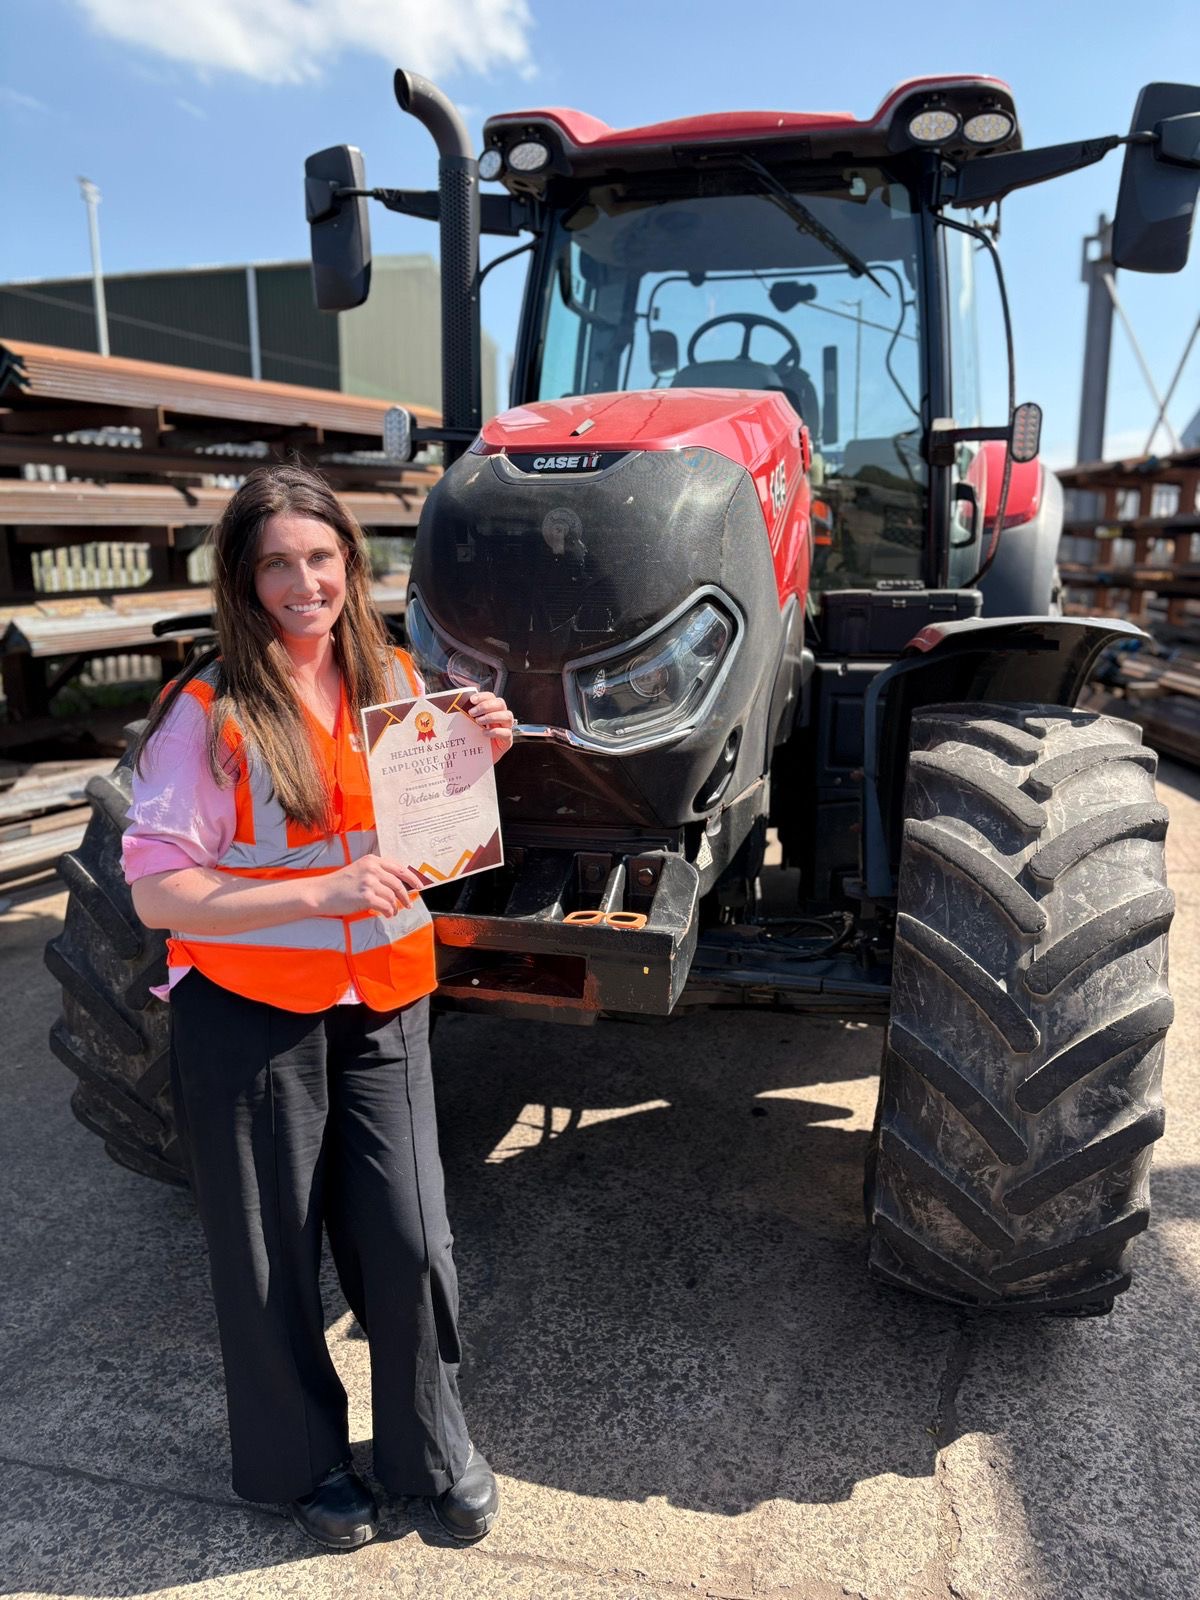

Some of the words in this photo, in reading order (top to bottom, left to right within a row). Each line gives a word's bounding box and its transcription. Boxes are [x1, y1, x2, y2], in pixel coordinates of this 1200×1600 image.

[533, 456, 581, 470] CASE
[390, 745, 425, 761] HEALTH
[426, 744, 433, 752] &
[434, 737, 466, 751] SAFETY
[382, 755, 440, 776] EMPLOYEE
[443, 751, 458, 761] OF
[461, 746, 484, 757] THE
[414, 760, 454, 775] MONTH
[399, 791, 440, 807] Victoria
